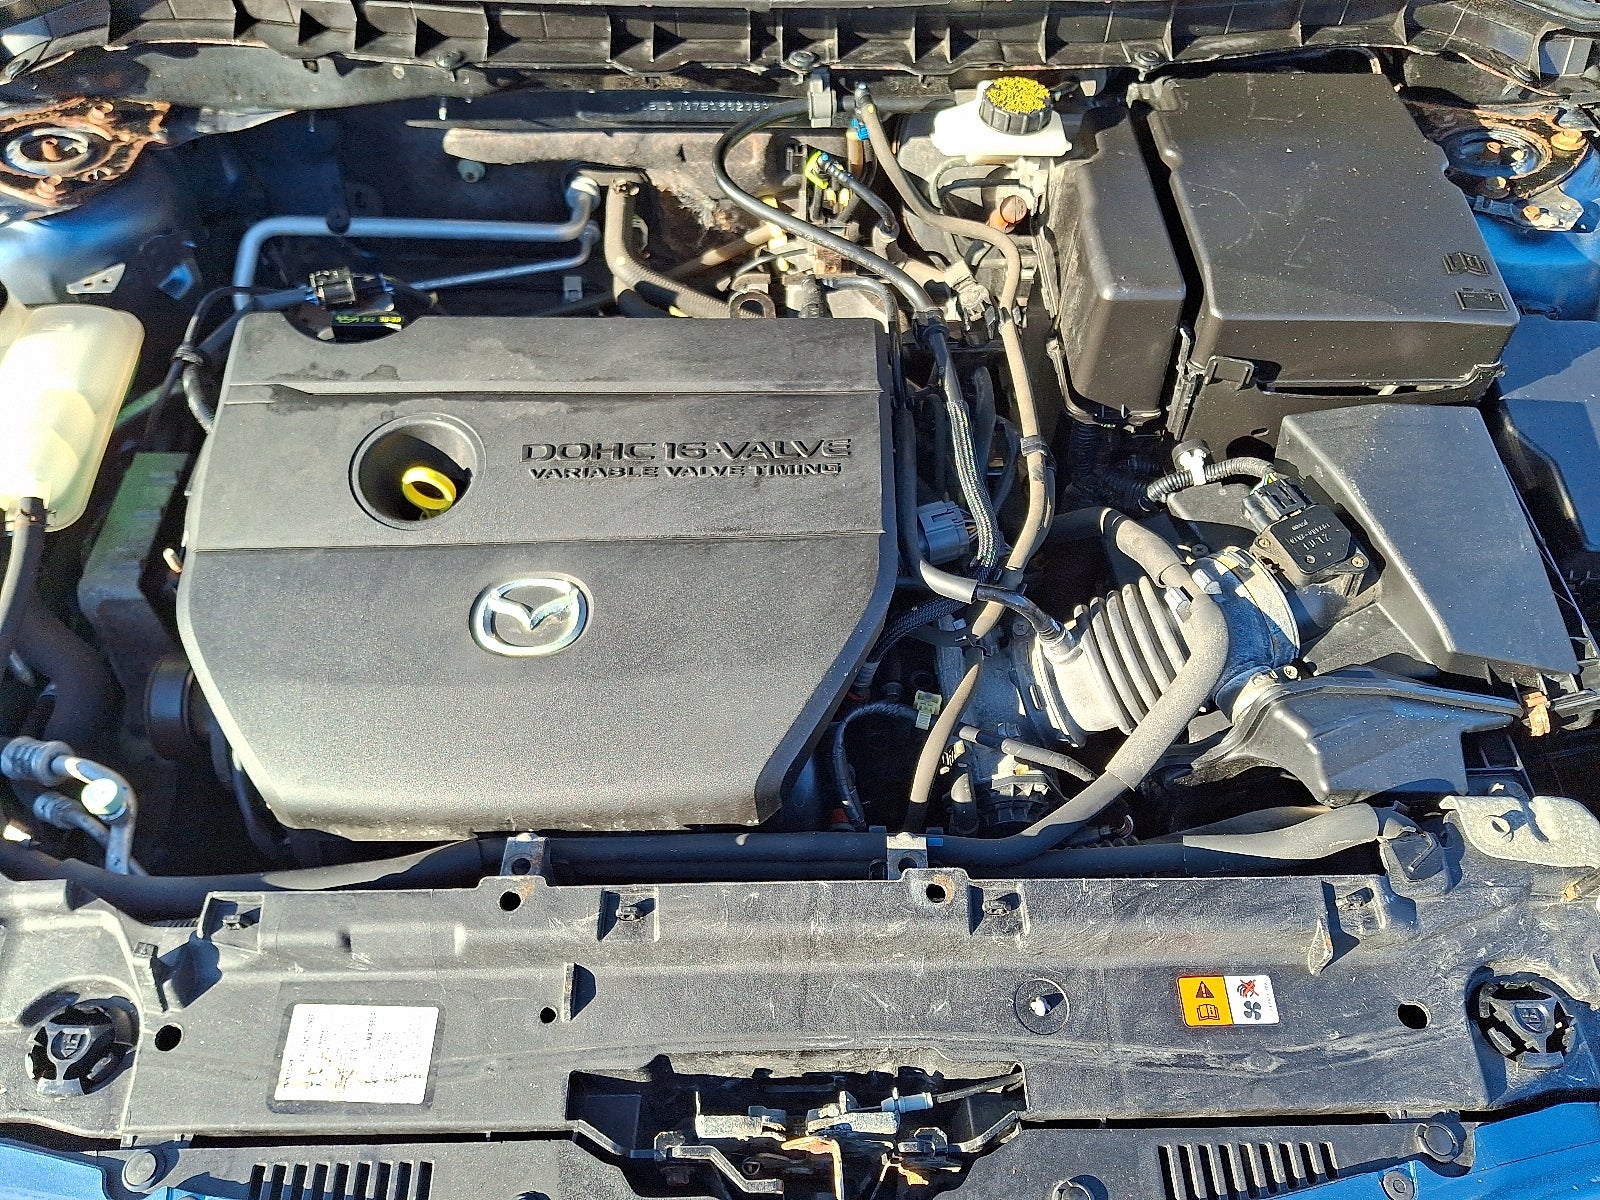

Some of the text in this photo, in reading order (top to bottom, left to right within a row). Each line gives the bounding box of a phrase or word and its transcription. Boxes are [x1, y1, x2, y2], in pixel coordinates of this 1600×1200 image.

[520, 443, 656, 462] DOHC
[529, 463, 842, 479] VARIABLE VALVE TIMING
